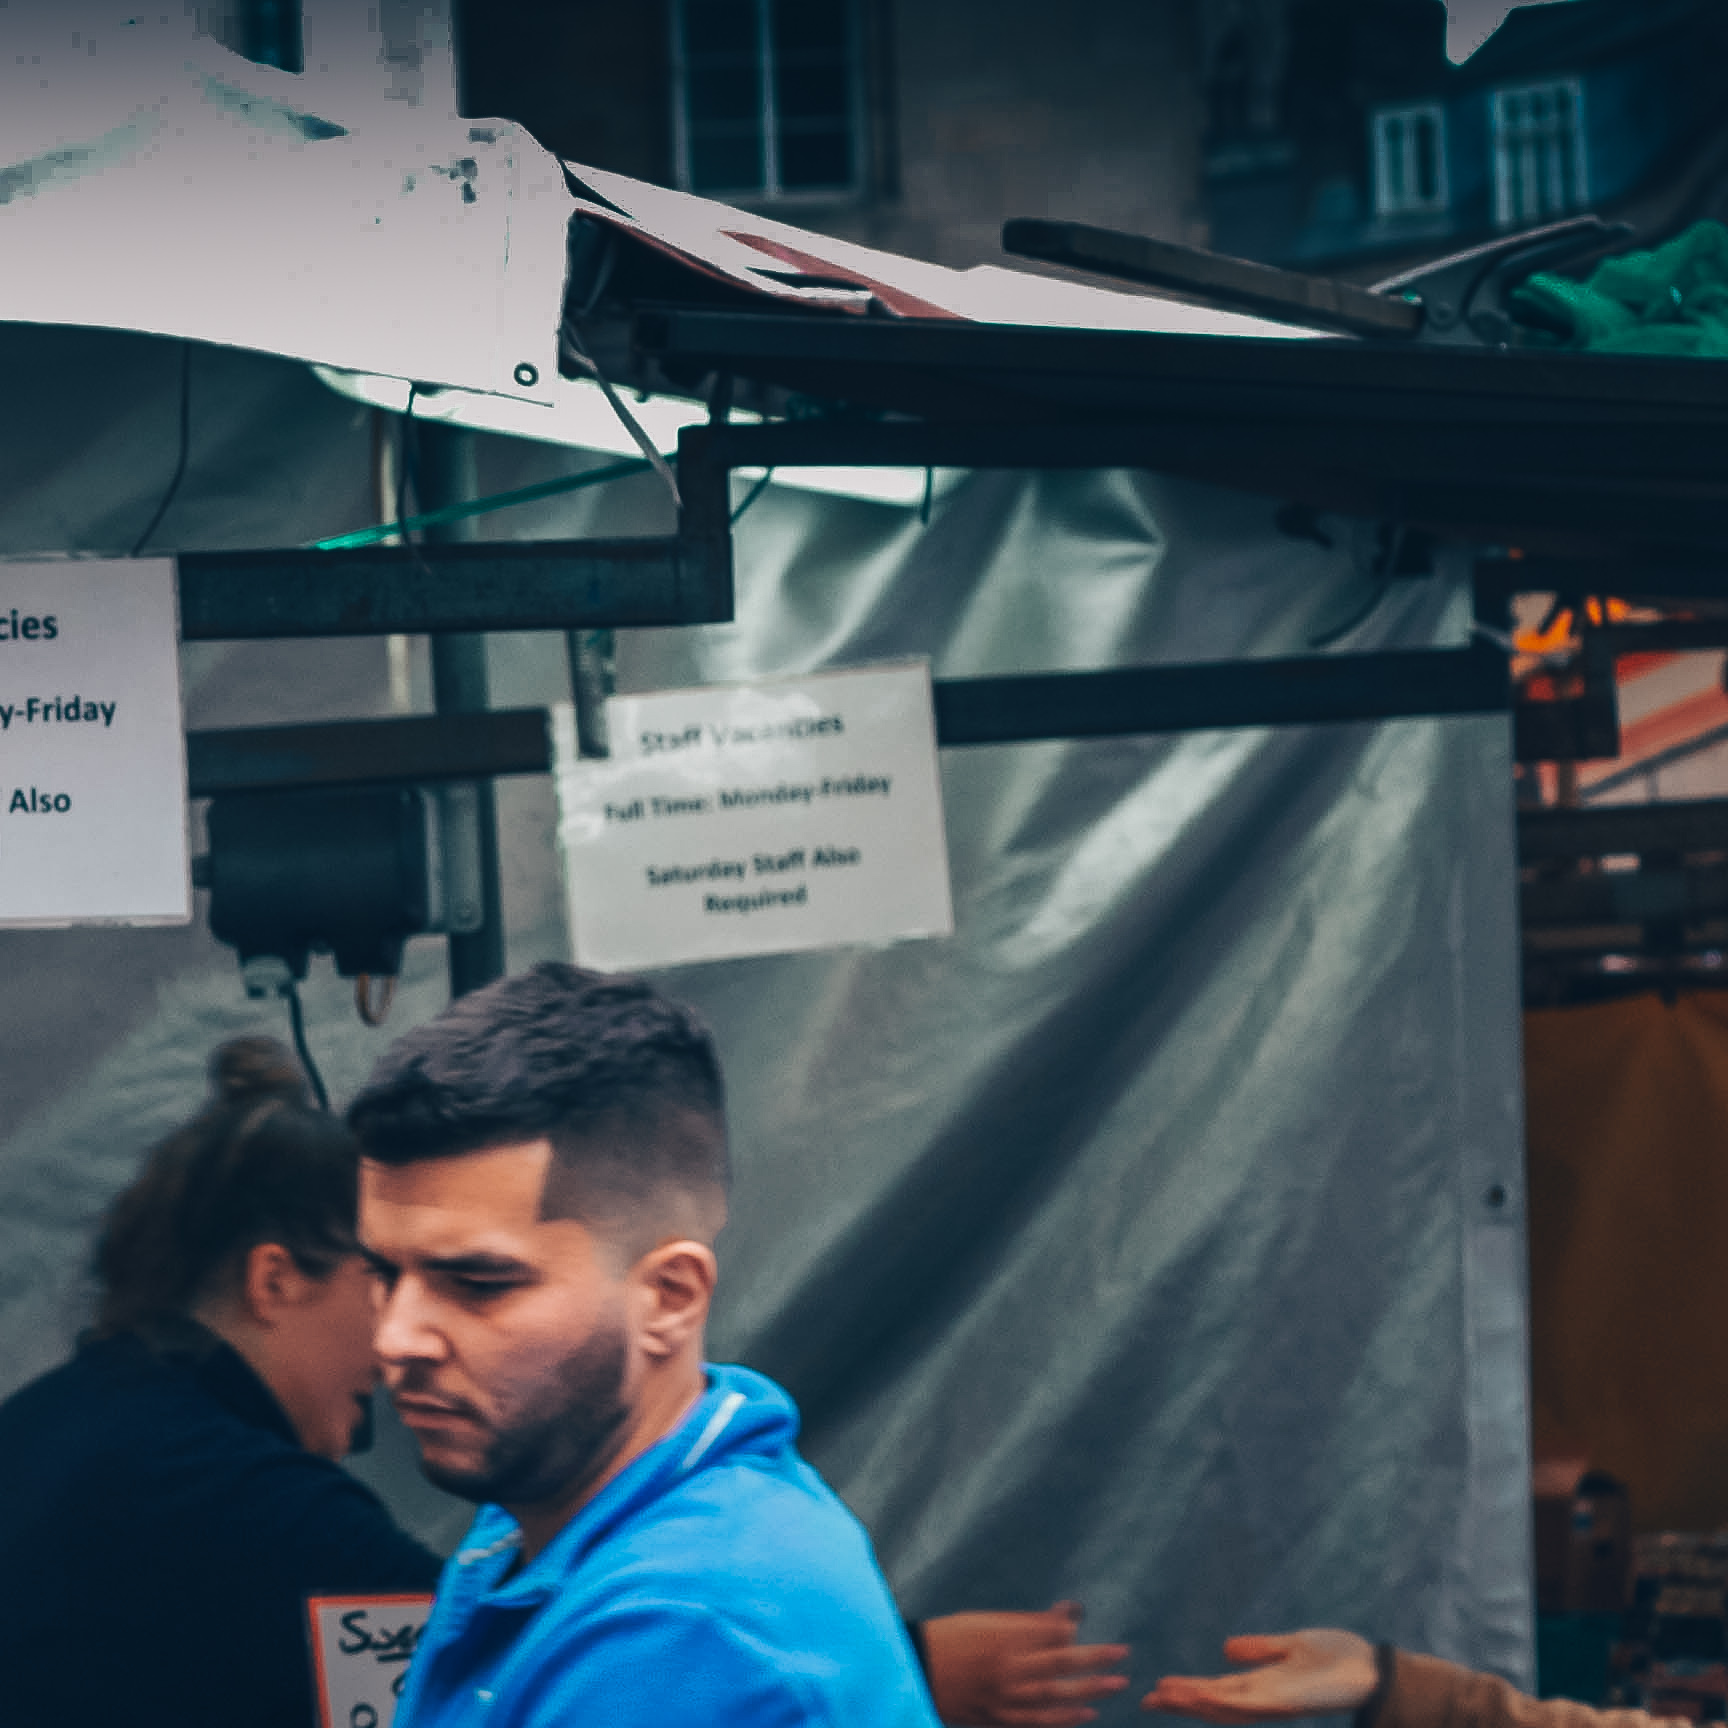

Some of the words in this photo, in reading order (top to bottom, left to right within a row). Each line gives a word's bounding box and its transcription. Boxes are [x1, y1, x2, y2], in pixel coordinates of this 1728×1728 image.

[8, 787, 72, 815] Also
[604, 800, 645, 822] Full
[646, 859, 746, 888] Saturday
[752, 848, 806, 875] Staff
[811, 846, 862, 868] Also
[702, 880, 808, 918] Required
